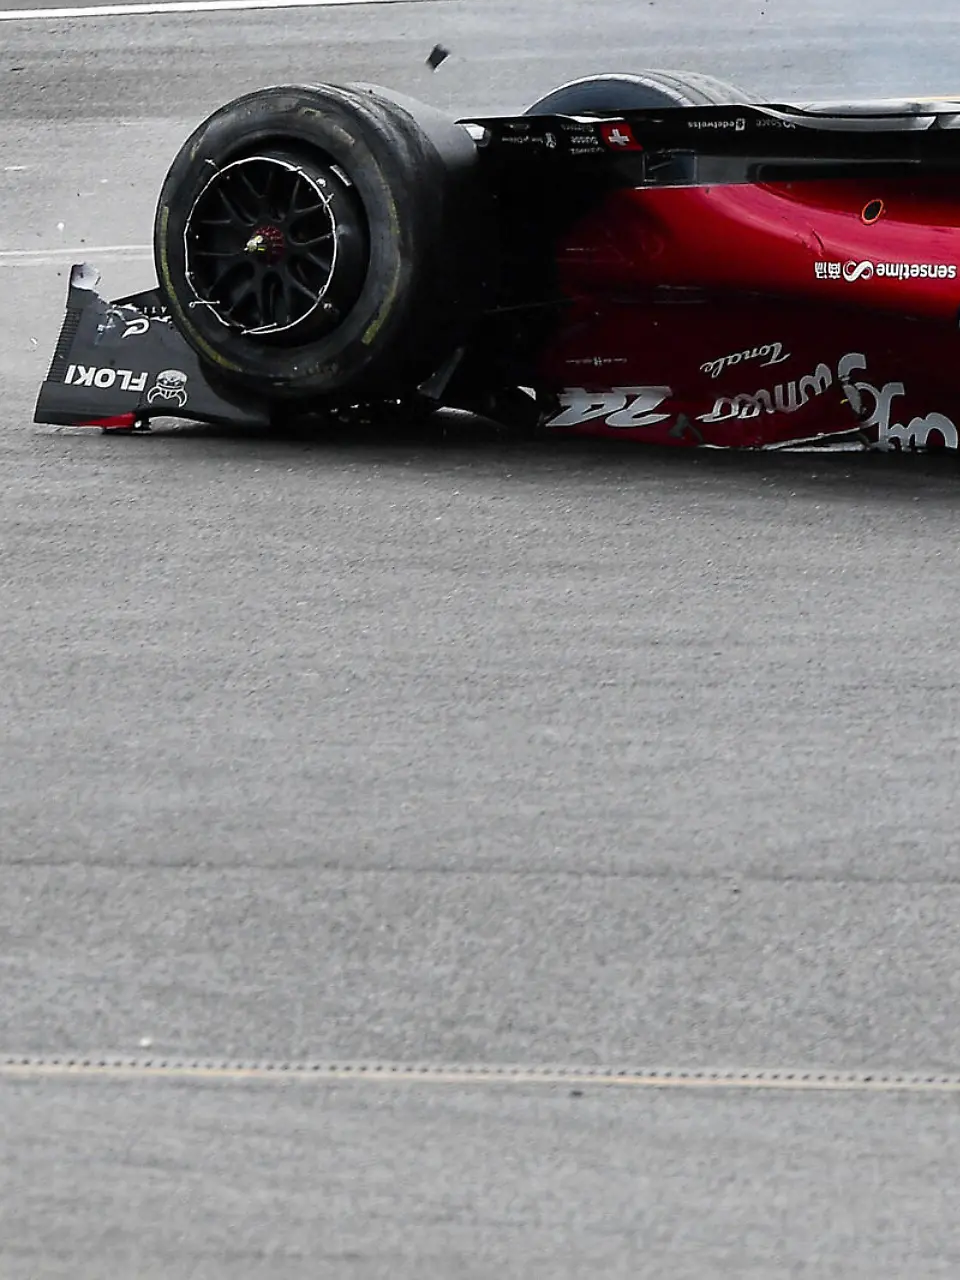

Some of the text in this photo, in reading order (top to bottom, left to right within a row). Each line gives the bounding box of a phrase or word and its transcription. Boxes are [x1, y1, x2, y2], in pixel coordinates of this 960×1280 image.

[687, 117, 735, 131] edelweiss
[875, 261, 957, 280] sensetime
[700, 341, 791, 379] Tonale
[64, 362, 148, 392] FLOKI
[546, 385, 673, 428] 24
